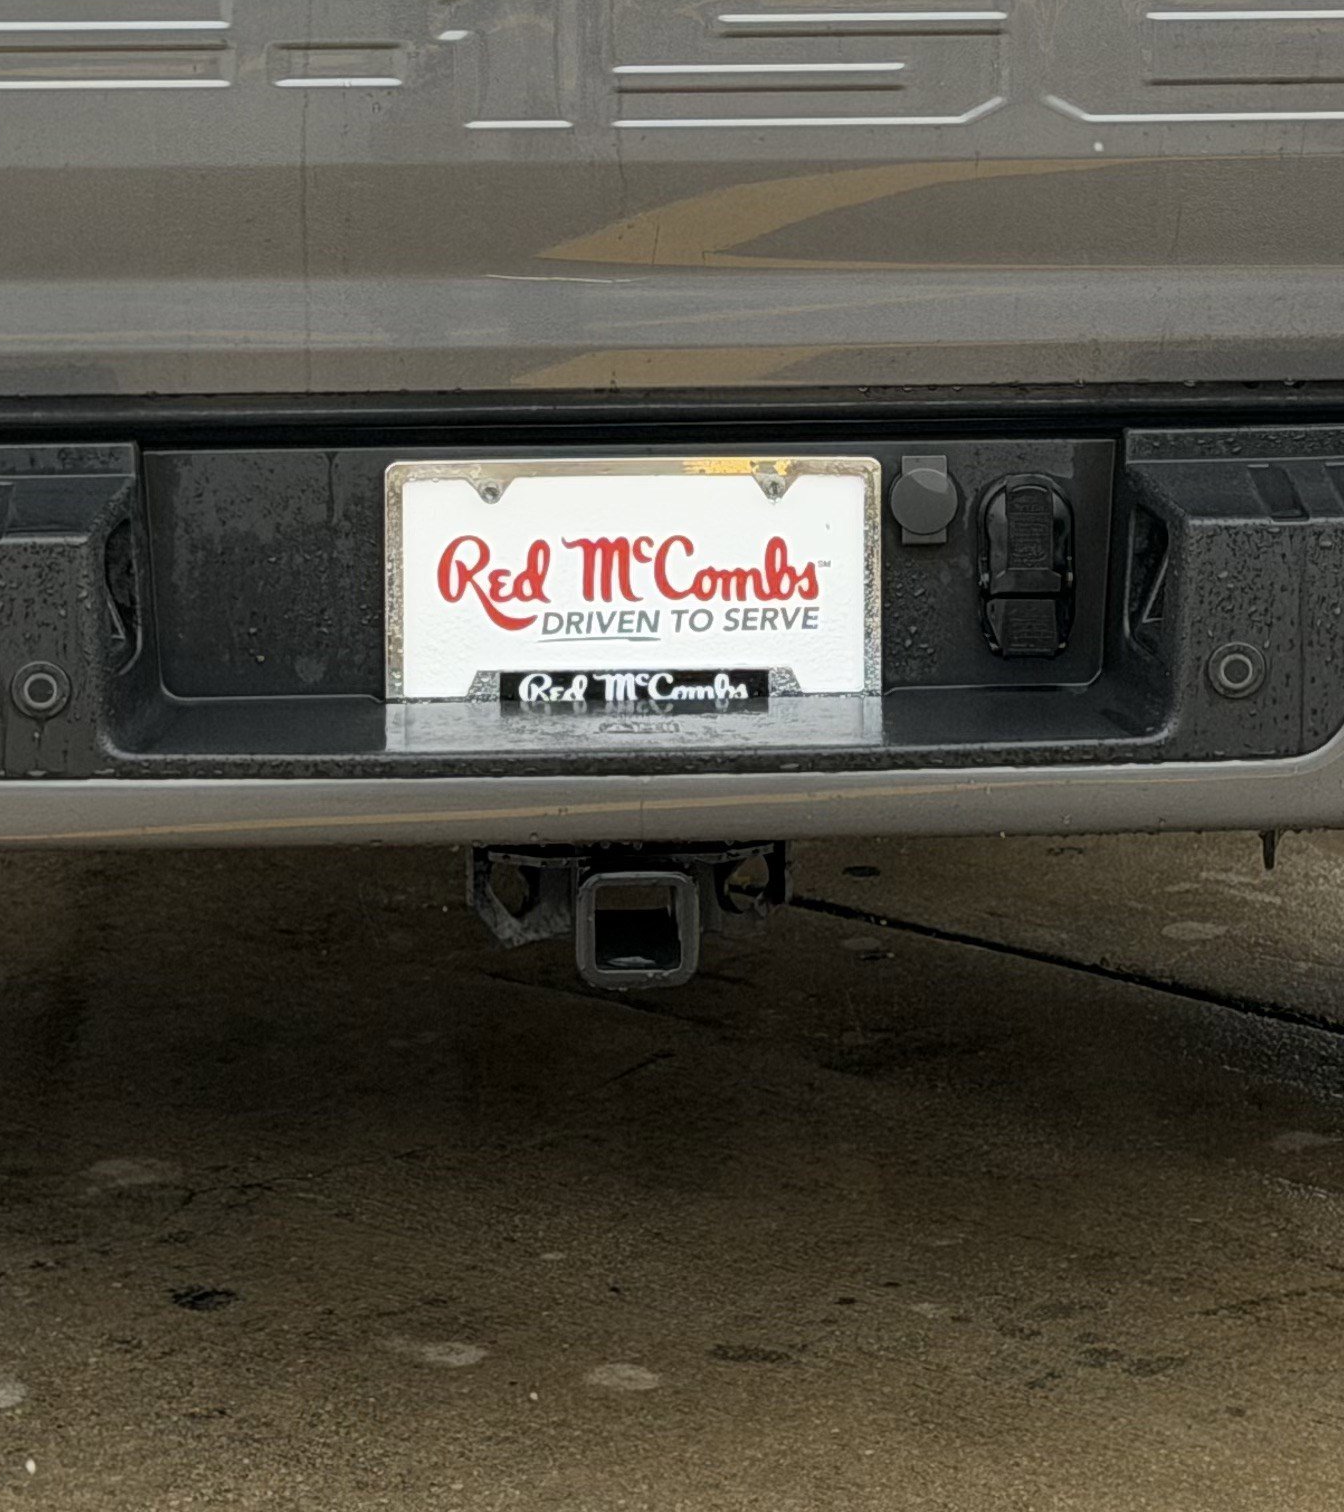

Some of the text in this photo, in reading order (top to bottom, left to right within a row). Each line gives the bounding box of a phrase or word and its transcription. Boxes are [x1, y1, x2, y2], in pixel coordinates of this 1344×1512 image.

[436, 534, 552, 631] Red
[561, 534, 820, 603] McCombs
[541, 605, 821, 636] DRIVEN TO SERVE
[518, 672, 749, 702] Red McCombs
